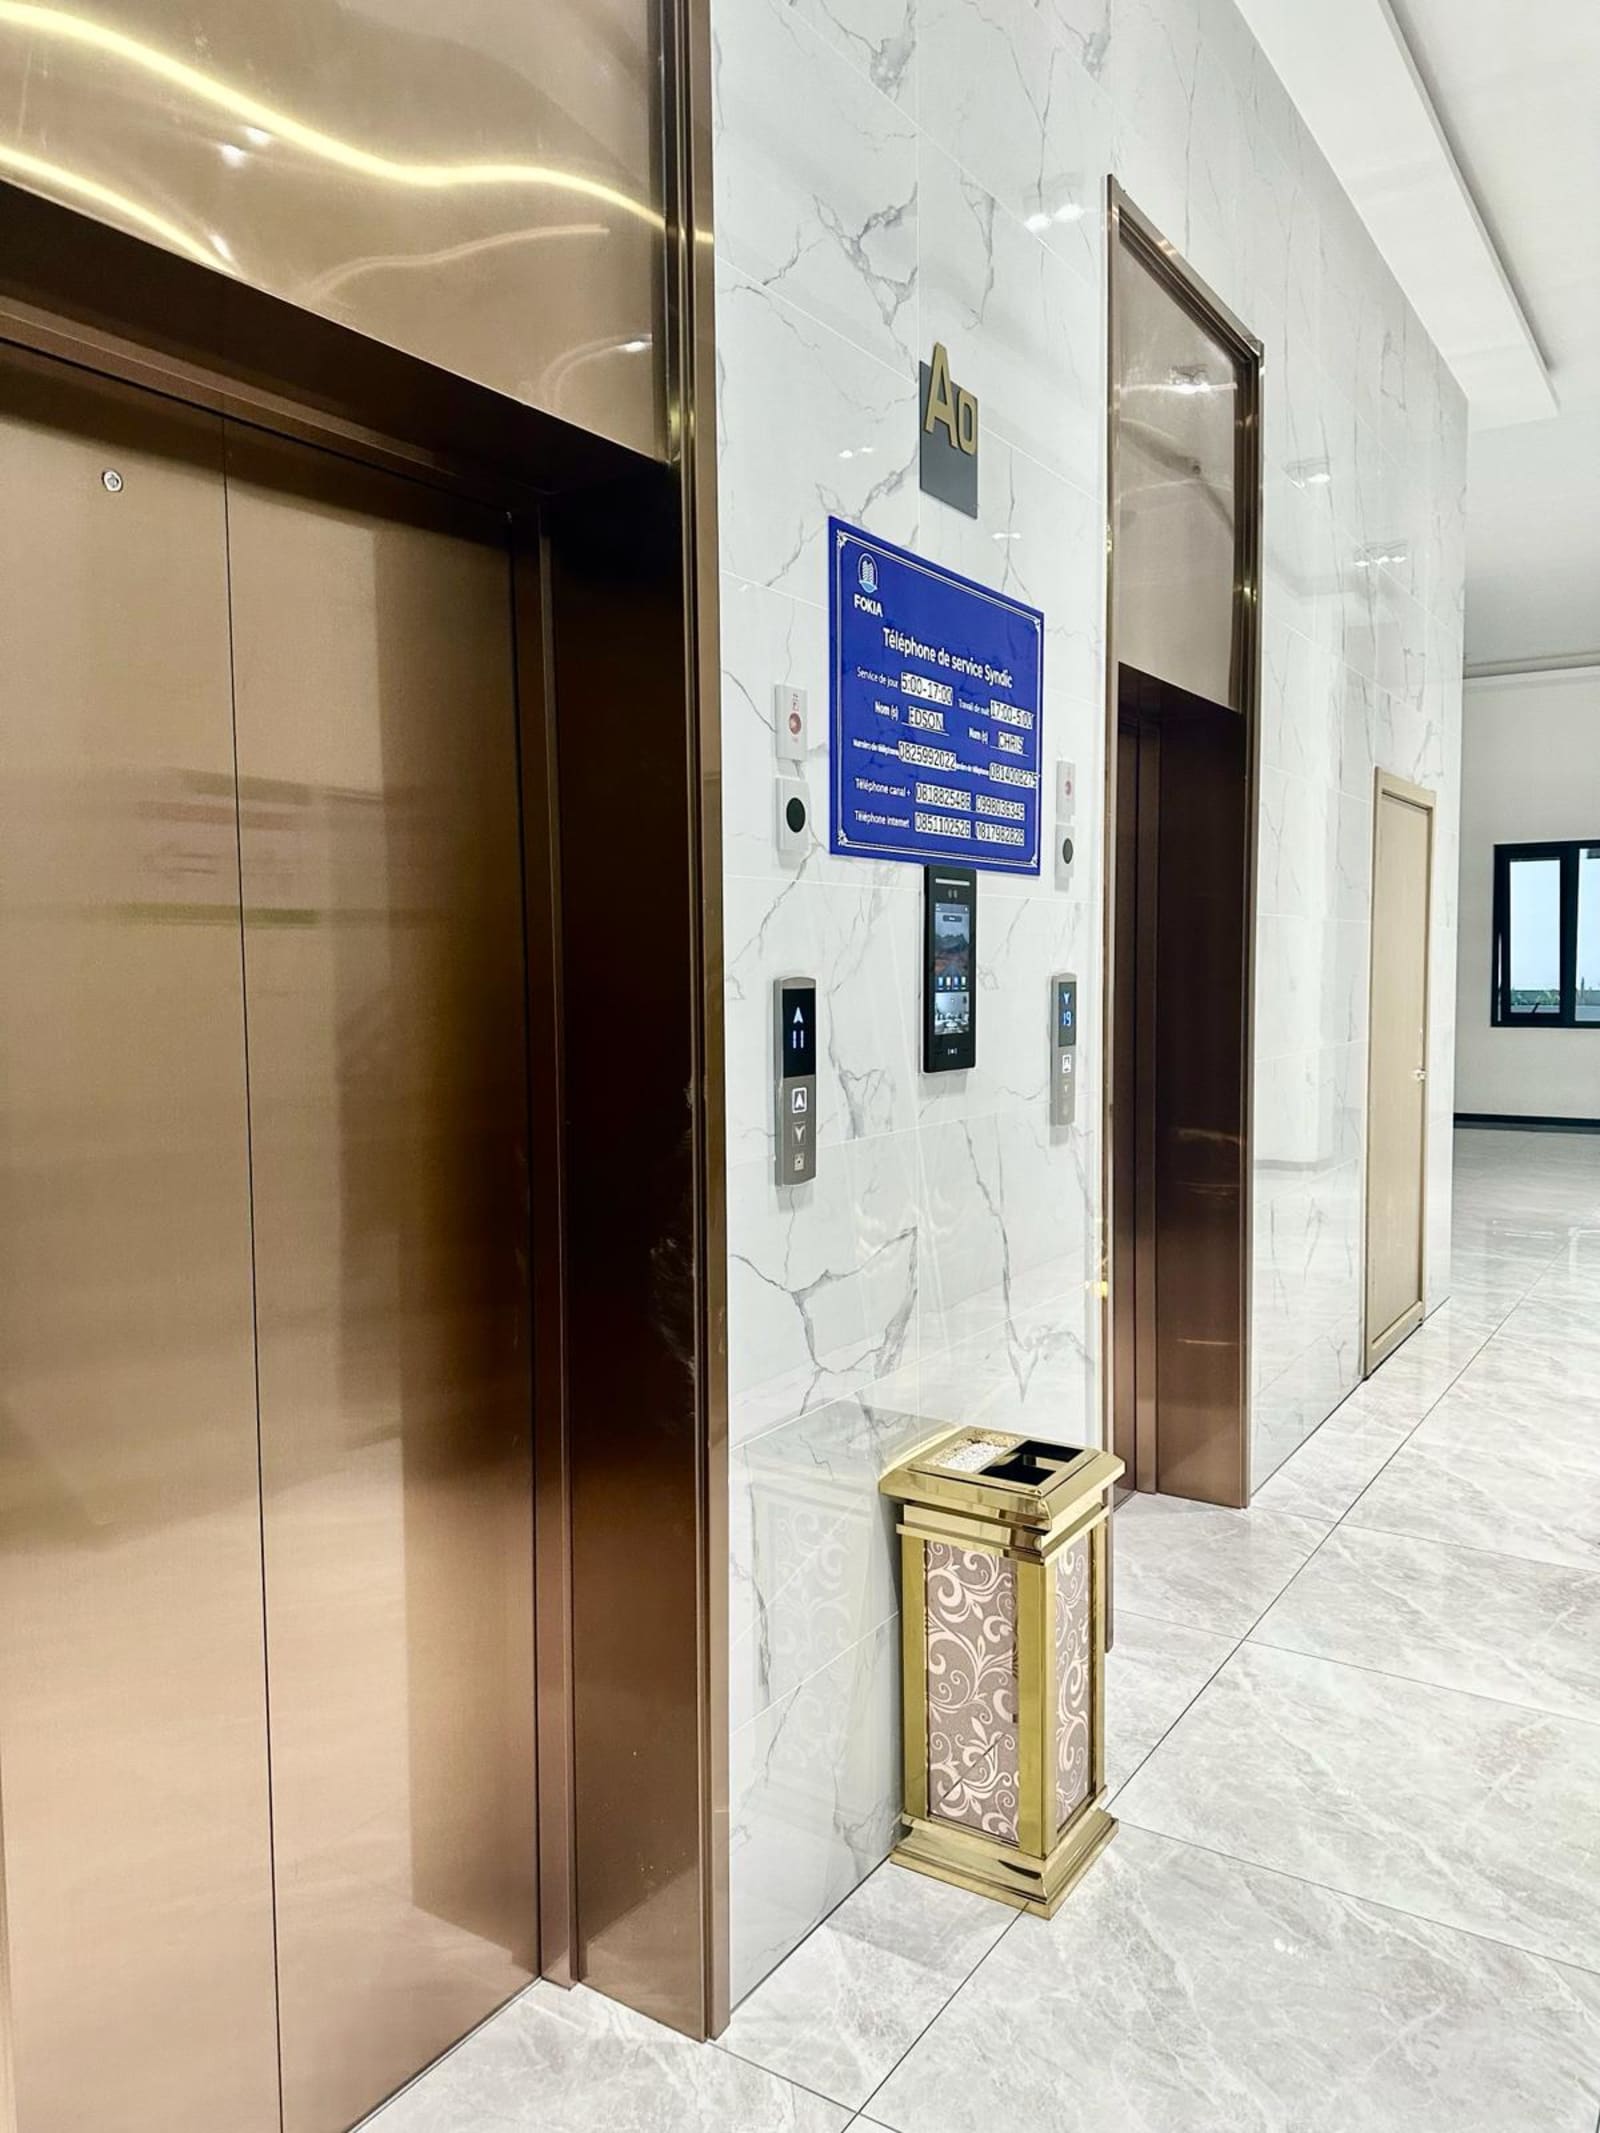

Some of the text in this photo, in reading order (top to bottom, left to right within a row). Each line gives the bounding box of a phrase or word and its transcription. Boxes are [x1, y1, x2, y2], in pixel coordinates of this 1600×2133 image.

[854, 593, 883, 618] FOKIA
[882, 627, 1013, 689] Téléphone de service Syndic
[856, 666, 878, 682] Service
[878, 673, 886, 685] de
[886, 677, 898, 688] jour
[874, 701, 890, 716] Nom
[909, 707, 944, 731] EDSON
[998, 732, 1024, 754] CHRIS
[855, 777, 888, 793] Téléphone
[889, 786, 906, 798] canal
[854, 809, 886, 826] Téléphone
